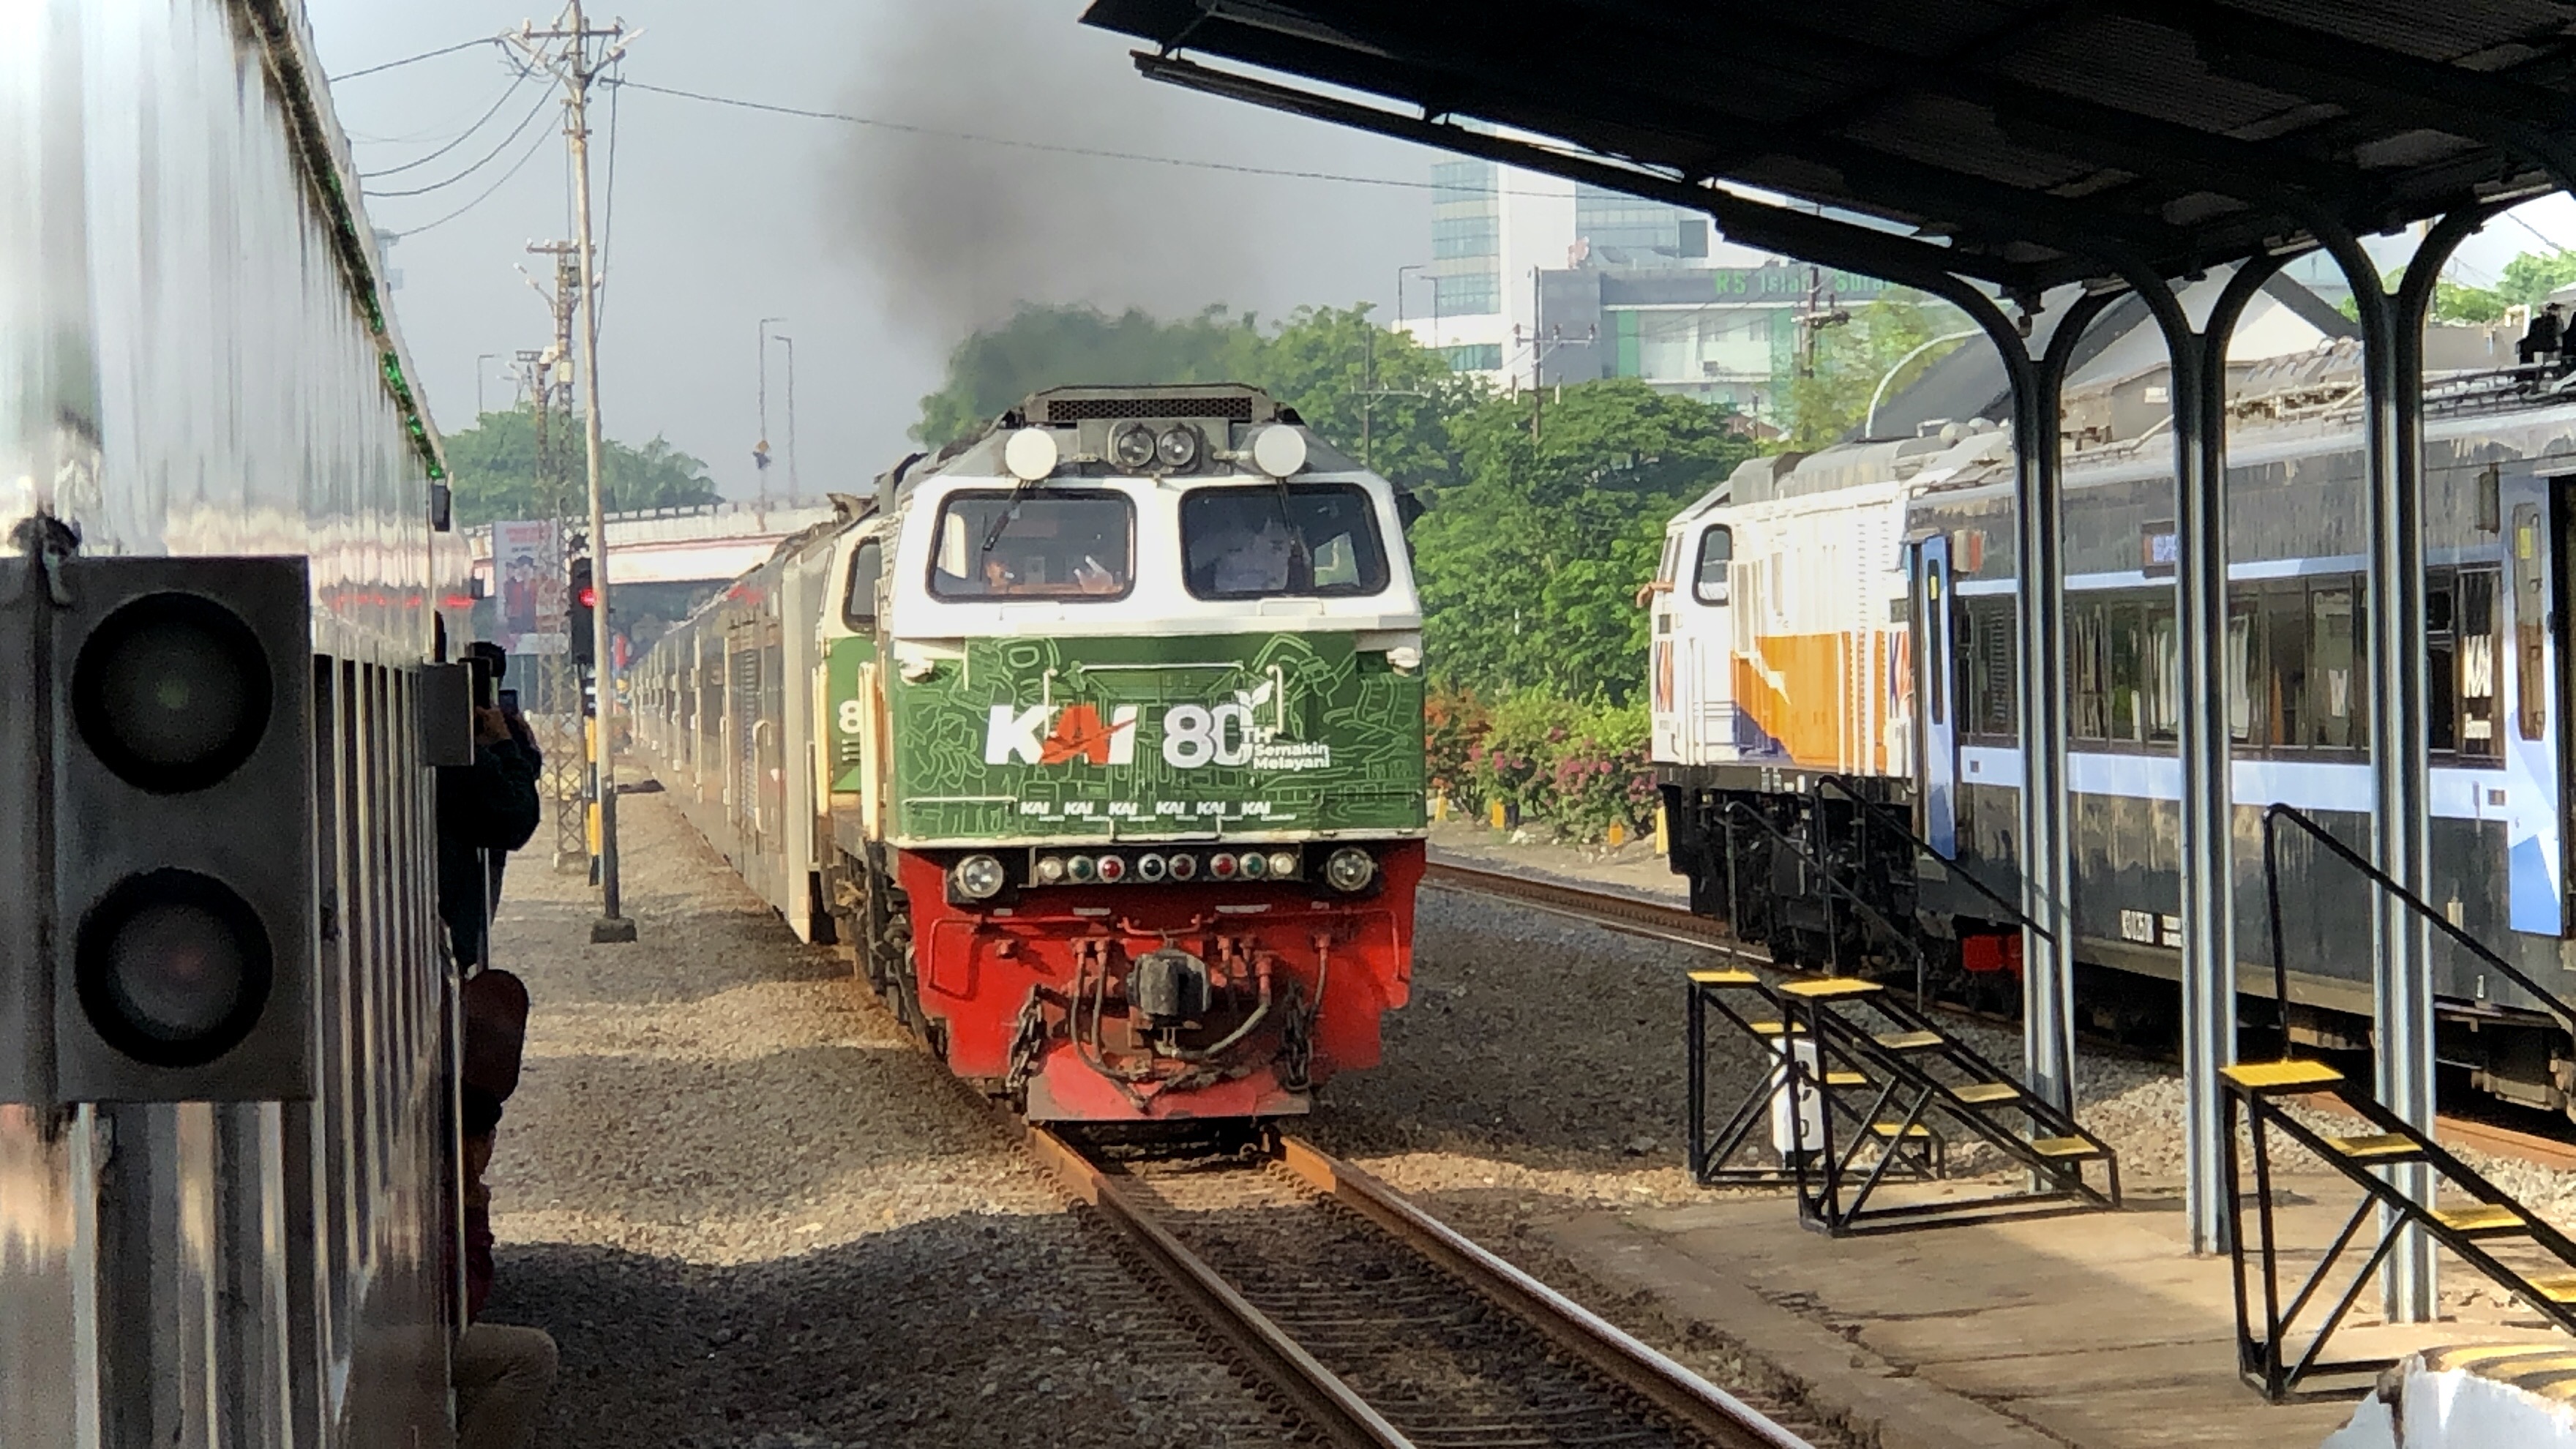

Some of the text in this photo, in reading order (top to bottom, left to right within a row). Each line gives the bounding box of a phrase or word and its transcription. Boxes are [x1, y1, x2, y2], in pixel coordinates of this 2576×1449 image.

[1716, 270, 1747, 293] RS
[985, 705, 1138, 765] KAI
[1163, 704, 1254, 768] 80
[1254, 741, 1330, 757] Semakin
[1253, 754, 1330, 771] Melayani
